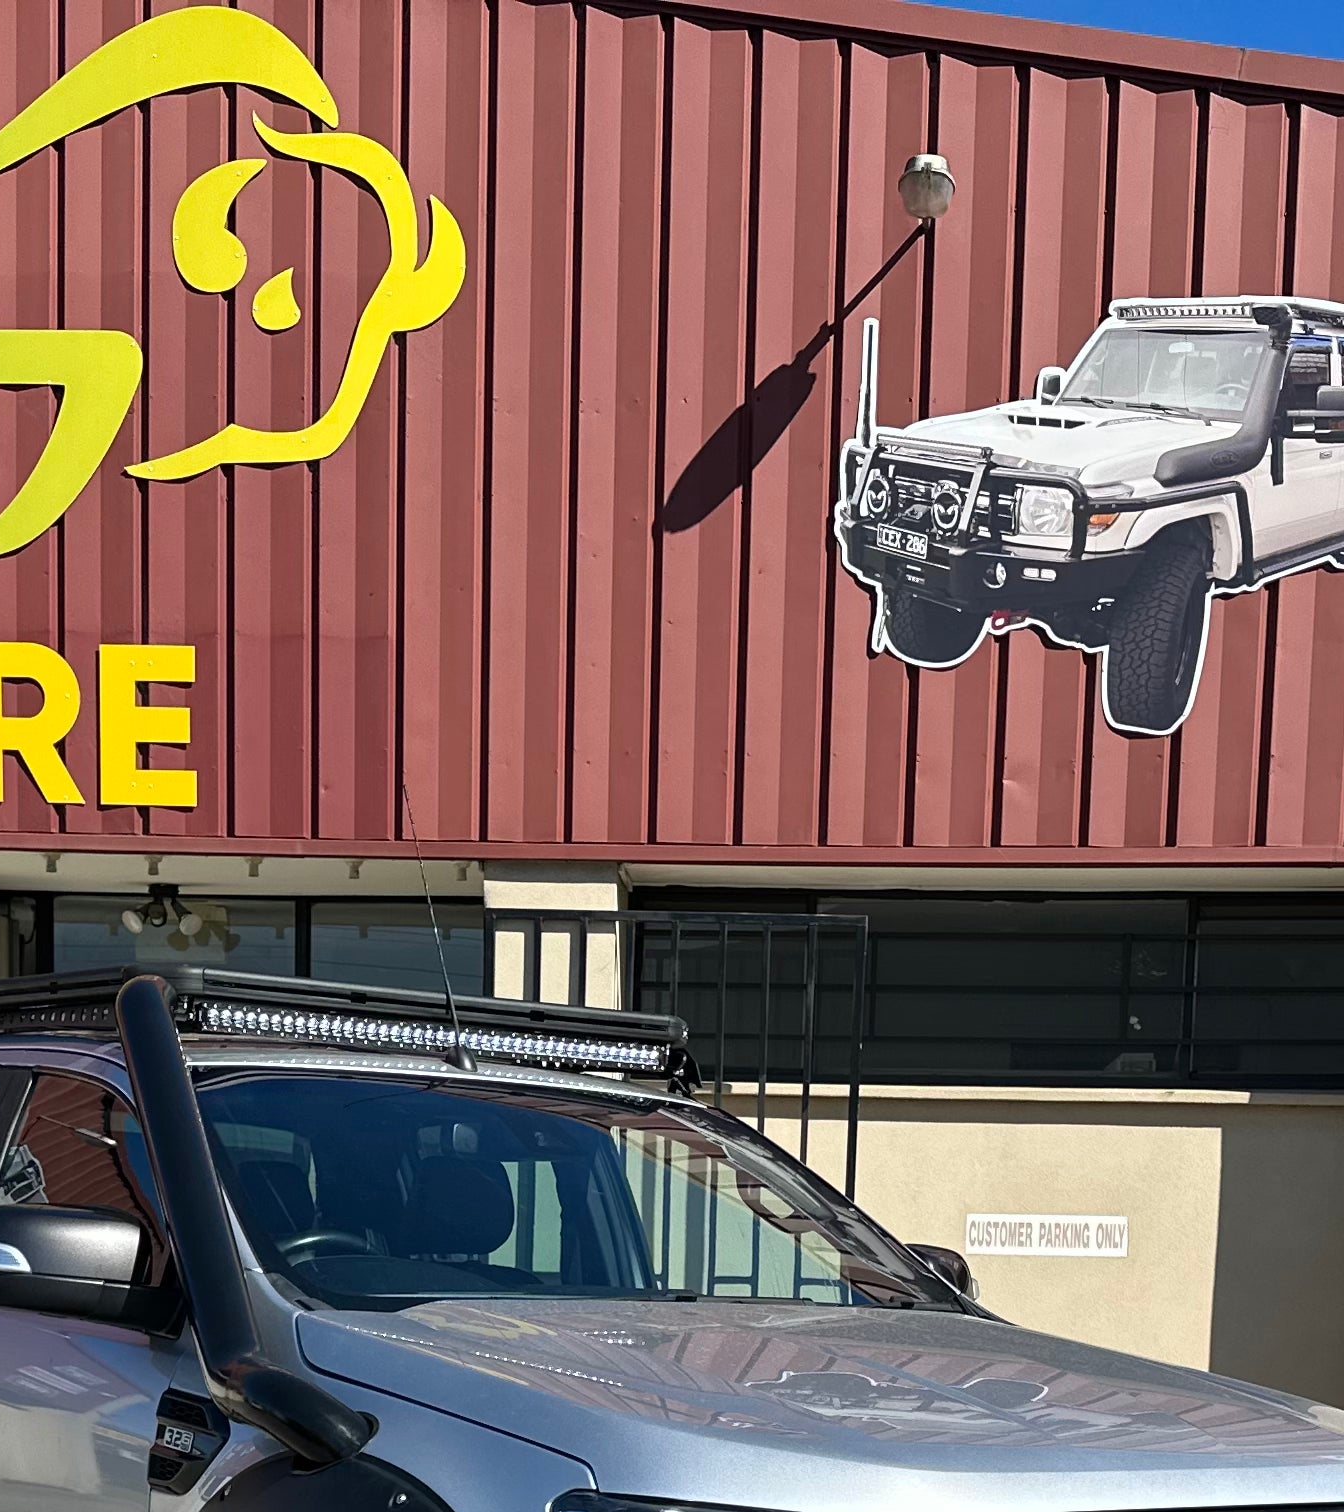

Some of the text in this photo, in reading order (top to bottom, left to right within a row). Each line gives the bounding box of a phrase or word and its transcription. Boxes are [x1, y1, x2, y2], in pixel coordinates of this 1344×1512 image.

[968, 1220, 1126, 1250] CUSTOMER PARKING ONLY
